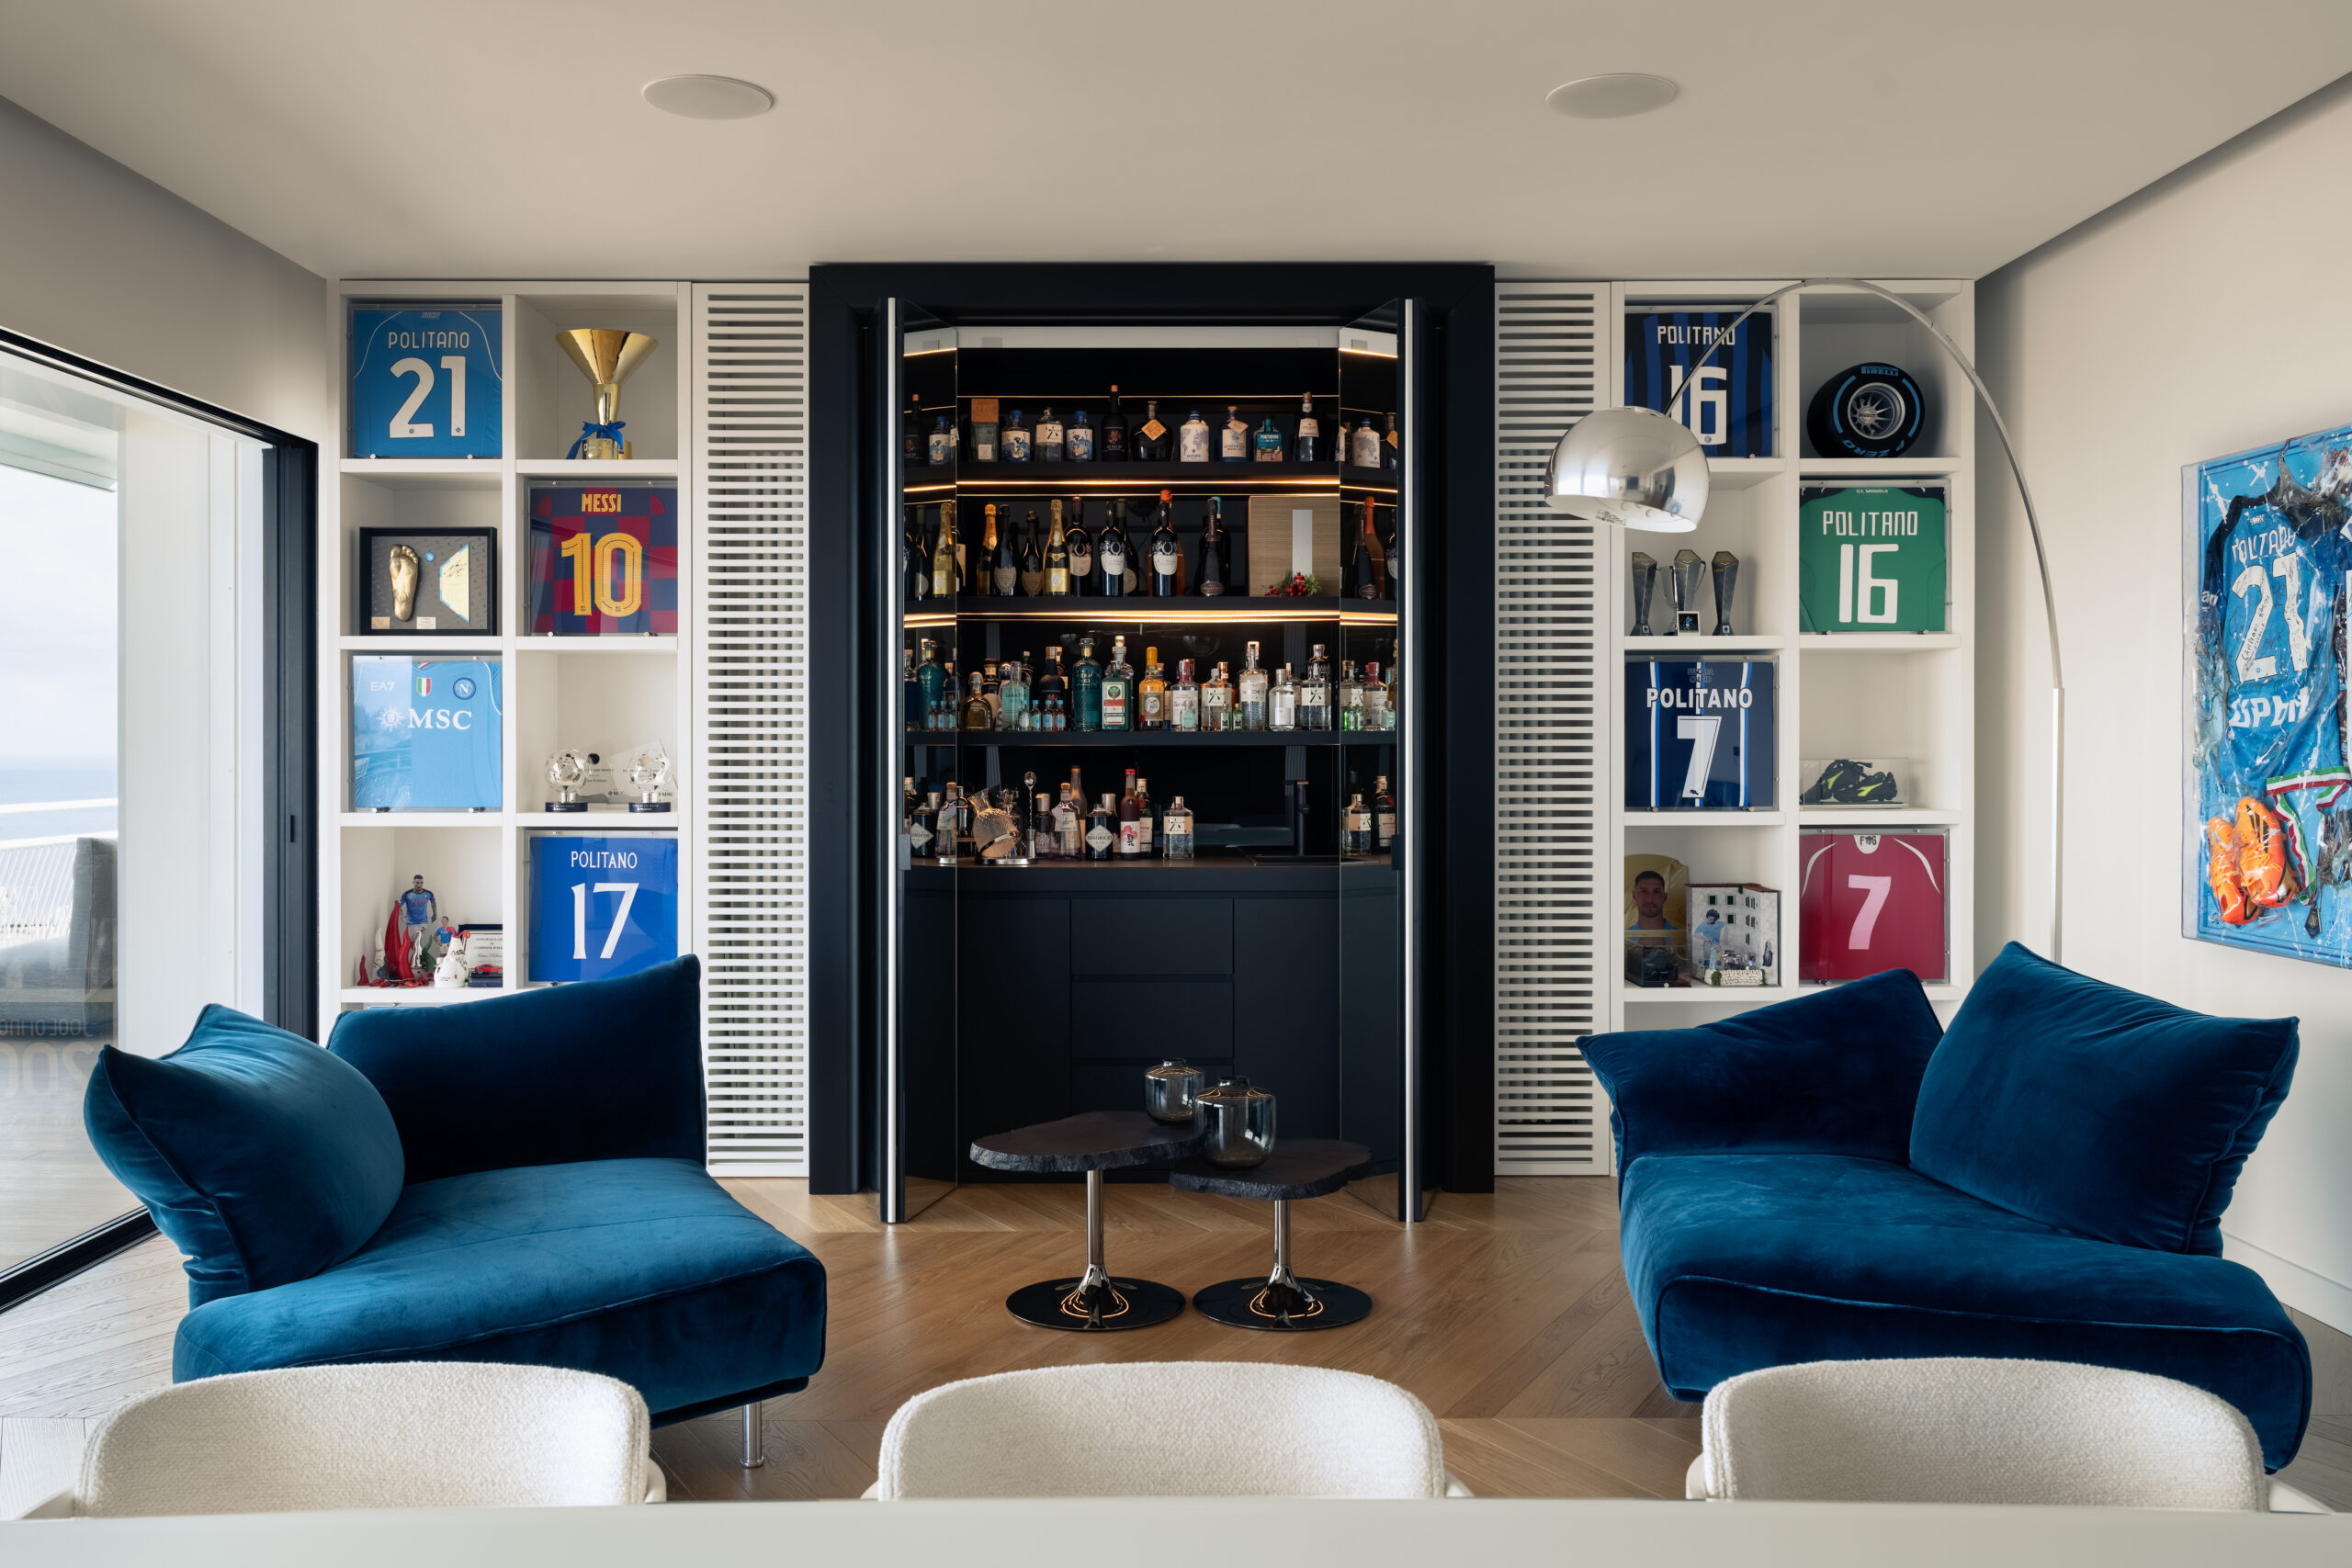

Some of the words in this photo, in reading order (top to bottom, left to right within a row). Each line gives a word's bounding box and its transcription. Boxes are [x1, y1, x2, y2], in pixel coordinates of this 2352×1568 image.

[388, 331, 470, 350] POLITANO
[1657, 325, 1736, 346] POLITANO
[1860, 366, 1899, 377] PIRELLI
[389, 355, 467, 439] 21
[1668, 365, 1727, 446] 16
[1842, 439, 1890, 457] ZERO
[1895, 440, 1905, 452] P
[582, 493, 622, 513] MESSI
[1822, 511, 1918, 537] POLITANO
[560, 532, 643, 617] 10
[1838, 543, 1900, 624] 16
[2231, 551, 2308, 682] 21
[369, 682, 395, 692] EA7
[459, 683, 469, 694] N
[1646, 687, 1753, 709] POLITANO
[408, 709, 472, 731] MSC
[1677, 716, 1723, 798] 7
[571, 851, 639, 870] POLITANO
[571, 882, 640, 960] 17
[1848, 874, 1893, 950] 7
